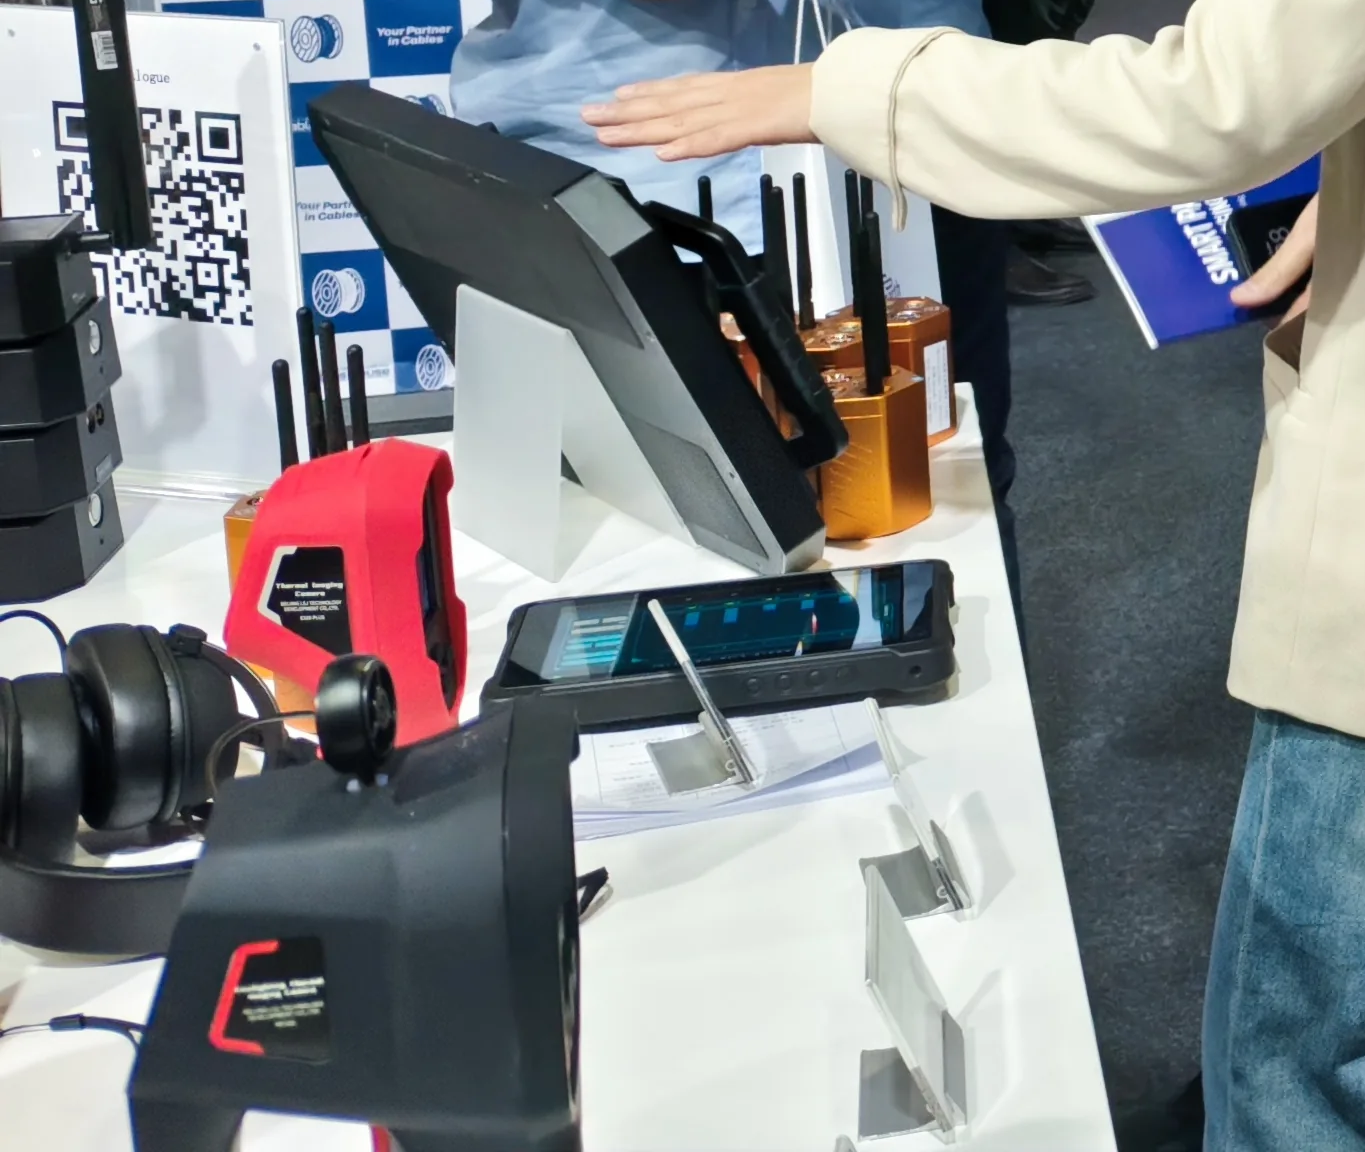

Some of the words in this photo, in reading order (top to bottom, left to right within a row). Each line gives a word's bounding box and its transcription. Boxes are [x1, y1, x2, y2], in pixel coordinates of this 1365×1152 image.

[377, 27, 404, 38] Your
[407, 25, 453, 36] Partner
[388, 37, 399, 46] in
[401, 36, 444, 47] Cables
[134, 69, 170, 84] logue
[305, 213, 315, 222] in
[1183, 222, 1239, 285] SMART
[312, 582, 343, 590] Imaging
